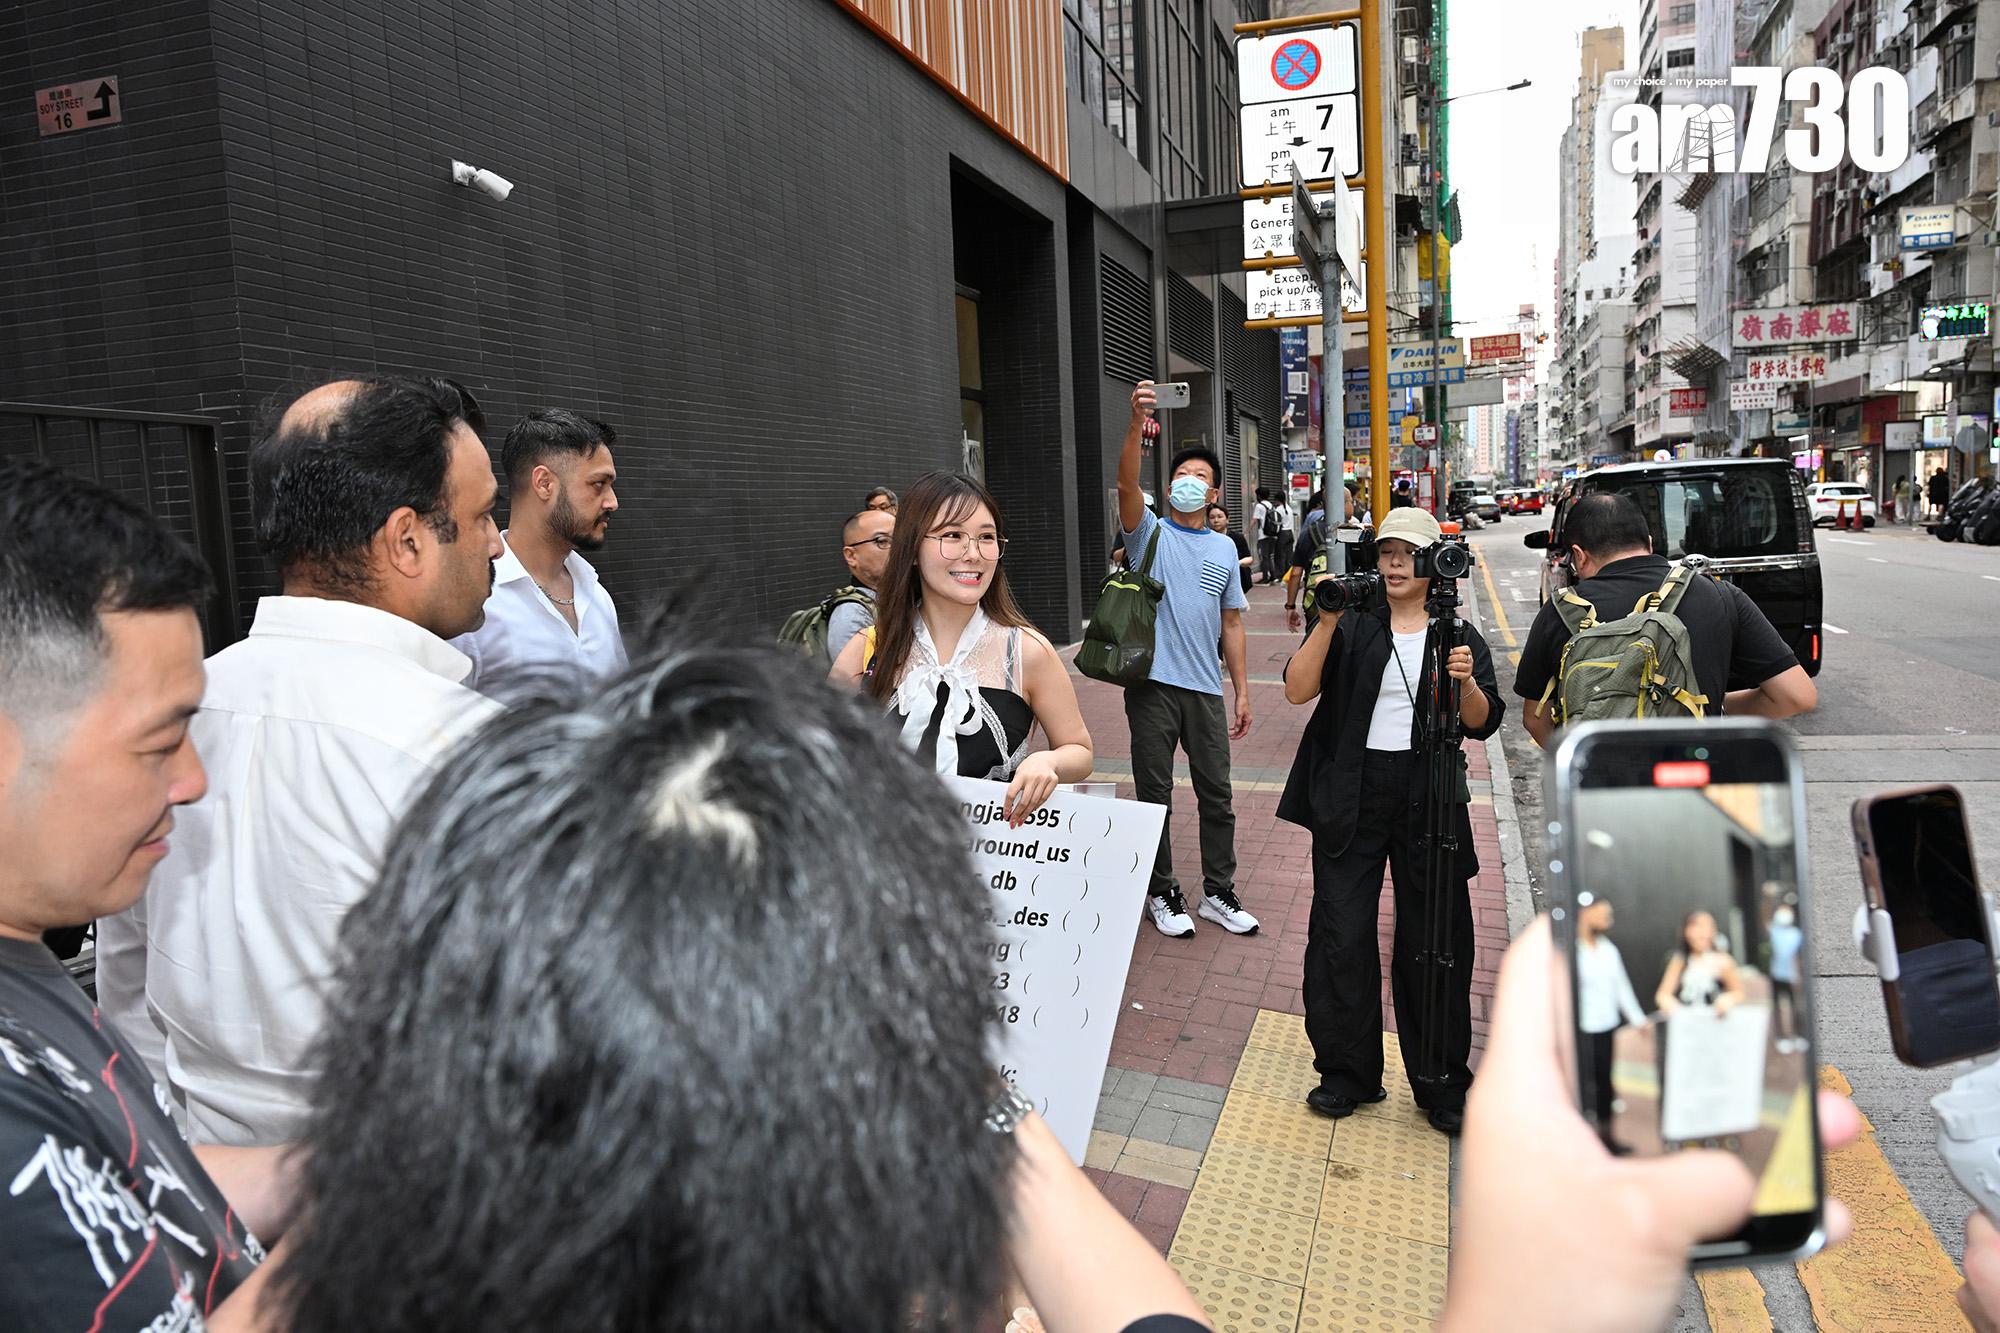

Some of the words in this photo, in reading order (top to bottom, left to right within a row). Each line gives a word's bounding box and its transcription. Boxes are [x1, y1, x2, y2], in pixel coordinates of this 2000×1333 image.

[40, 104, 55, 115] SOY
[55, 97, 83, 112] STREET
[54, 113, 73, 130] 16
[1270, 107, 1290, 117] am
[1316, 104, 1333, 130] 7
[1265, 121, 1297, 136] 上午
[1271, 150, 1291, 161] pm
[1317, 147, 1334, 173] 7
[1250, 218, 1295, 229] Genera
[1252, 234, 1294, 250] 公眾
[1274, 273, 1313, 284] Excep
[1260, 286, 1283, 298] pick
[1348, 383, 1370, 392] Pan
[966, 840, 1071, 864] around_us
[990, 870, 1017, 891] db
[984, 942, 1011, 962] ng
[990, 972, 1010, 990] z3
[998, 1005, 1020, 1023] 18
